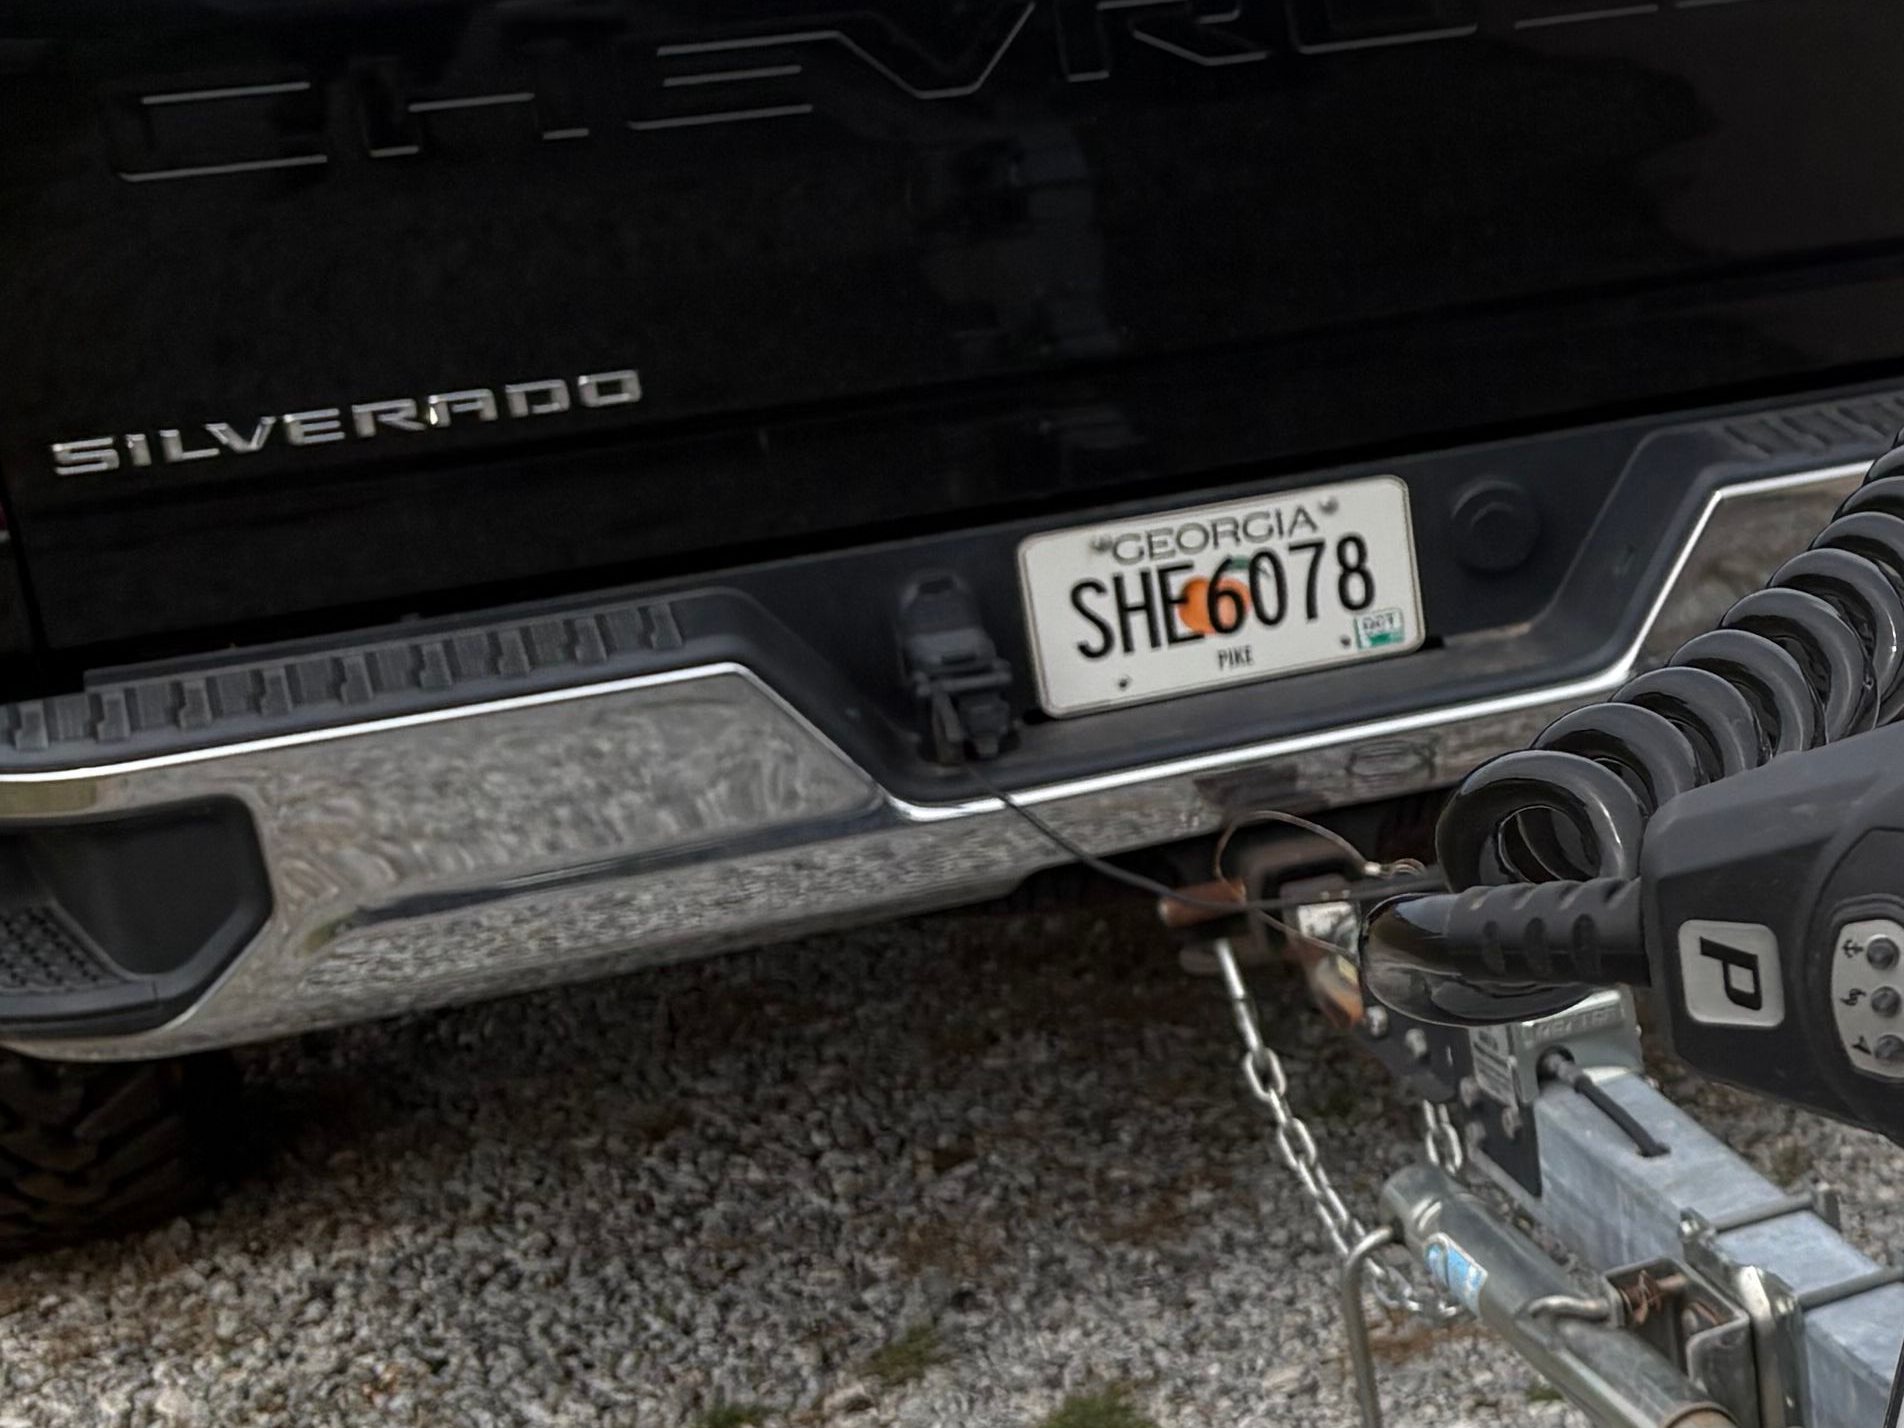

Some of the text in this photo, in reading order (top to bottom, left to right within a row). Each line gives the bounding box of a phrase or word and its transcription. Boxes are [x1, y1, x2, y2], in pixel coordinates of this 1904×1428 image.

[50, 368, 643, 477] SILVERADO
[1112, 505, 1319, 566] GEORGIA
[1069, 534, 1376, 660] SHE6078
[1217, 645, 1254, 670] PIKE
